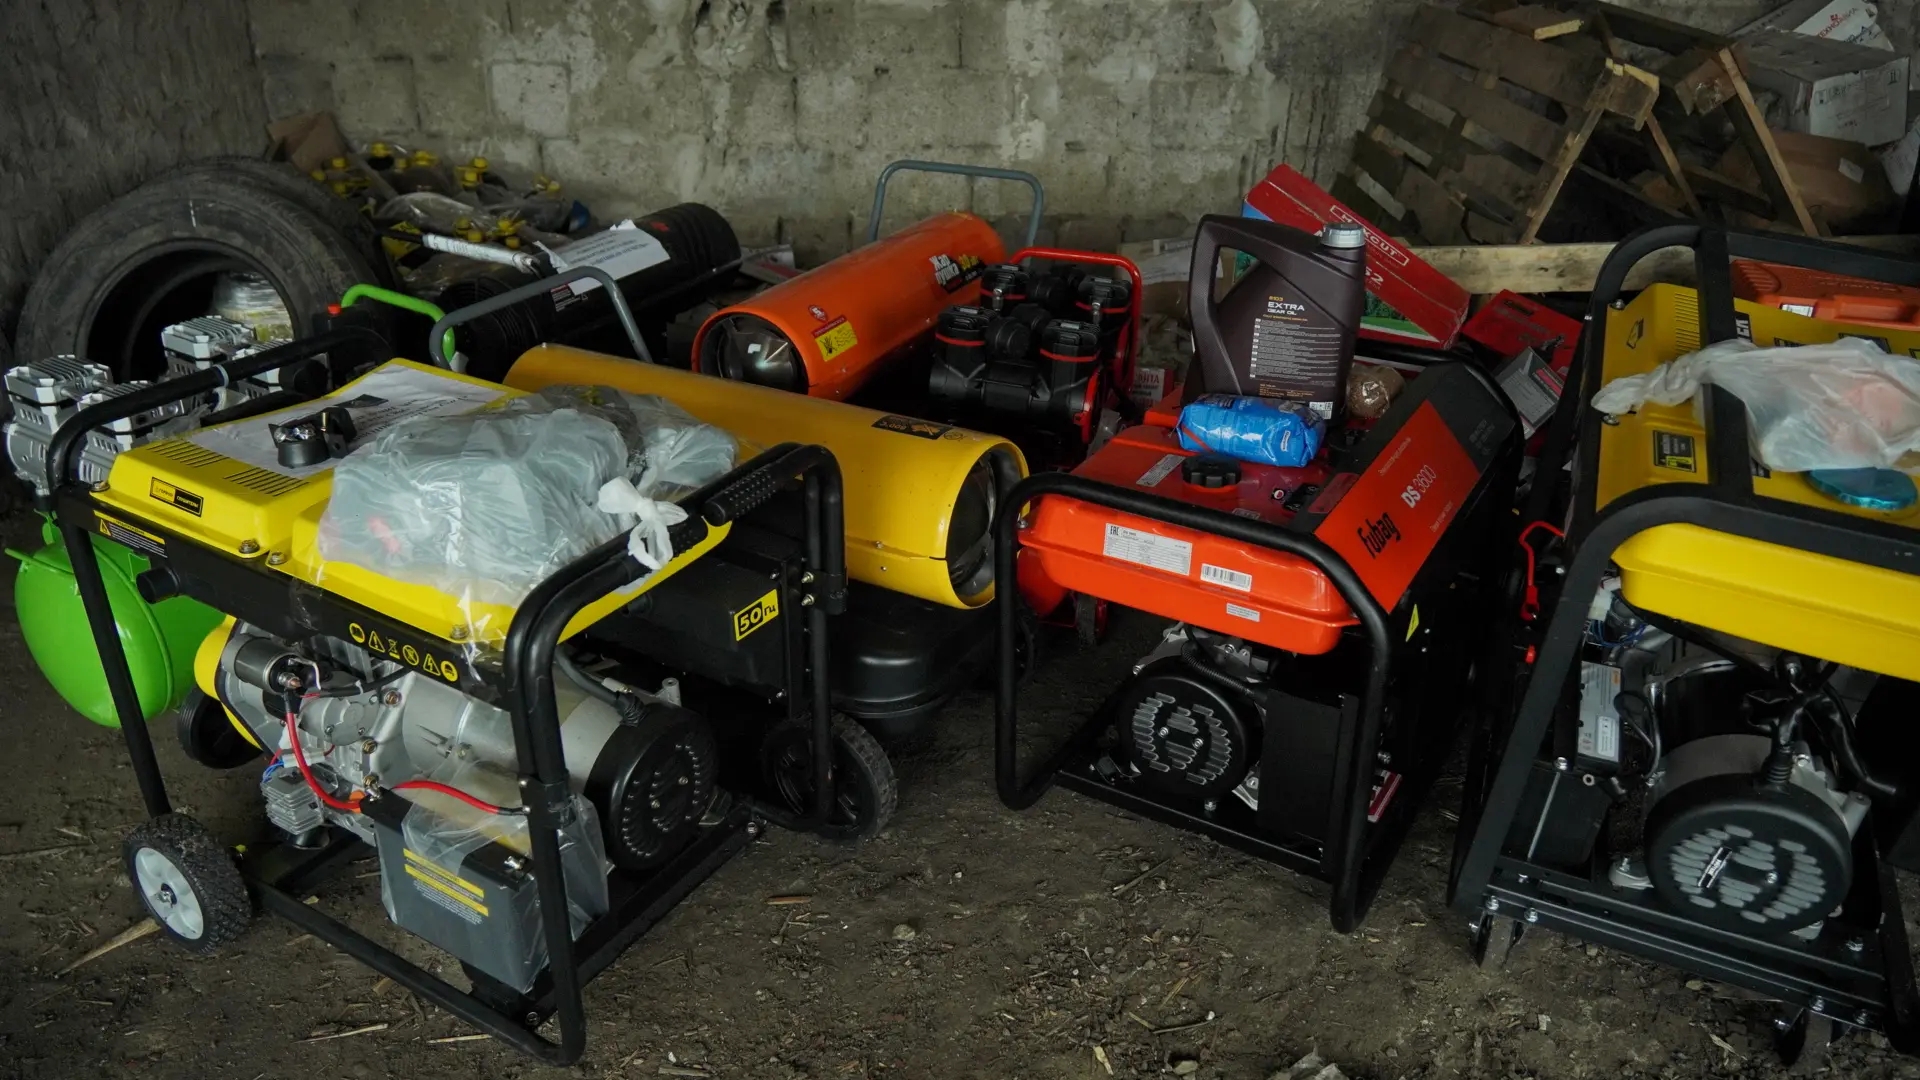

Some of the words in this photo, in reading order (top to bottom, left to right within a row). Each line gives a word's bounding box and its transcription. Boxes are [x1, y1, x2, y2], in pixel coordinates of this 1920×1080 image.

[1341, 213, 1398, 257] MXCUT
[1267, 301, 1305, 311] EXTRA
[1401, 485, 1421, 509] DS
[1413, 464, 1437, 493] 3600
[740, 607, 762, 632] 50
